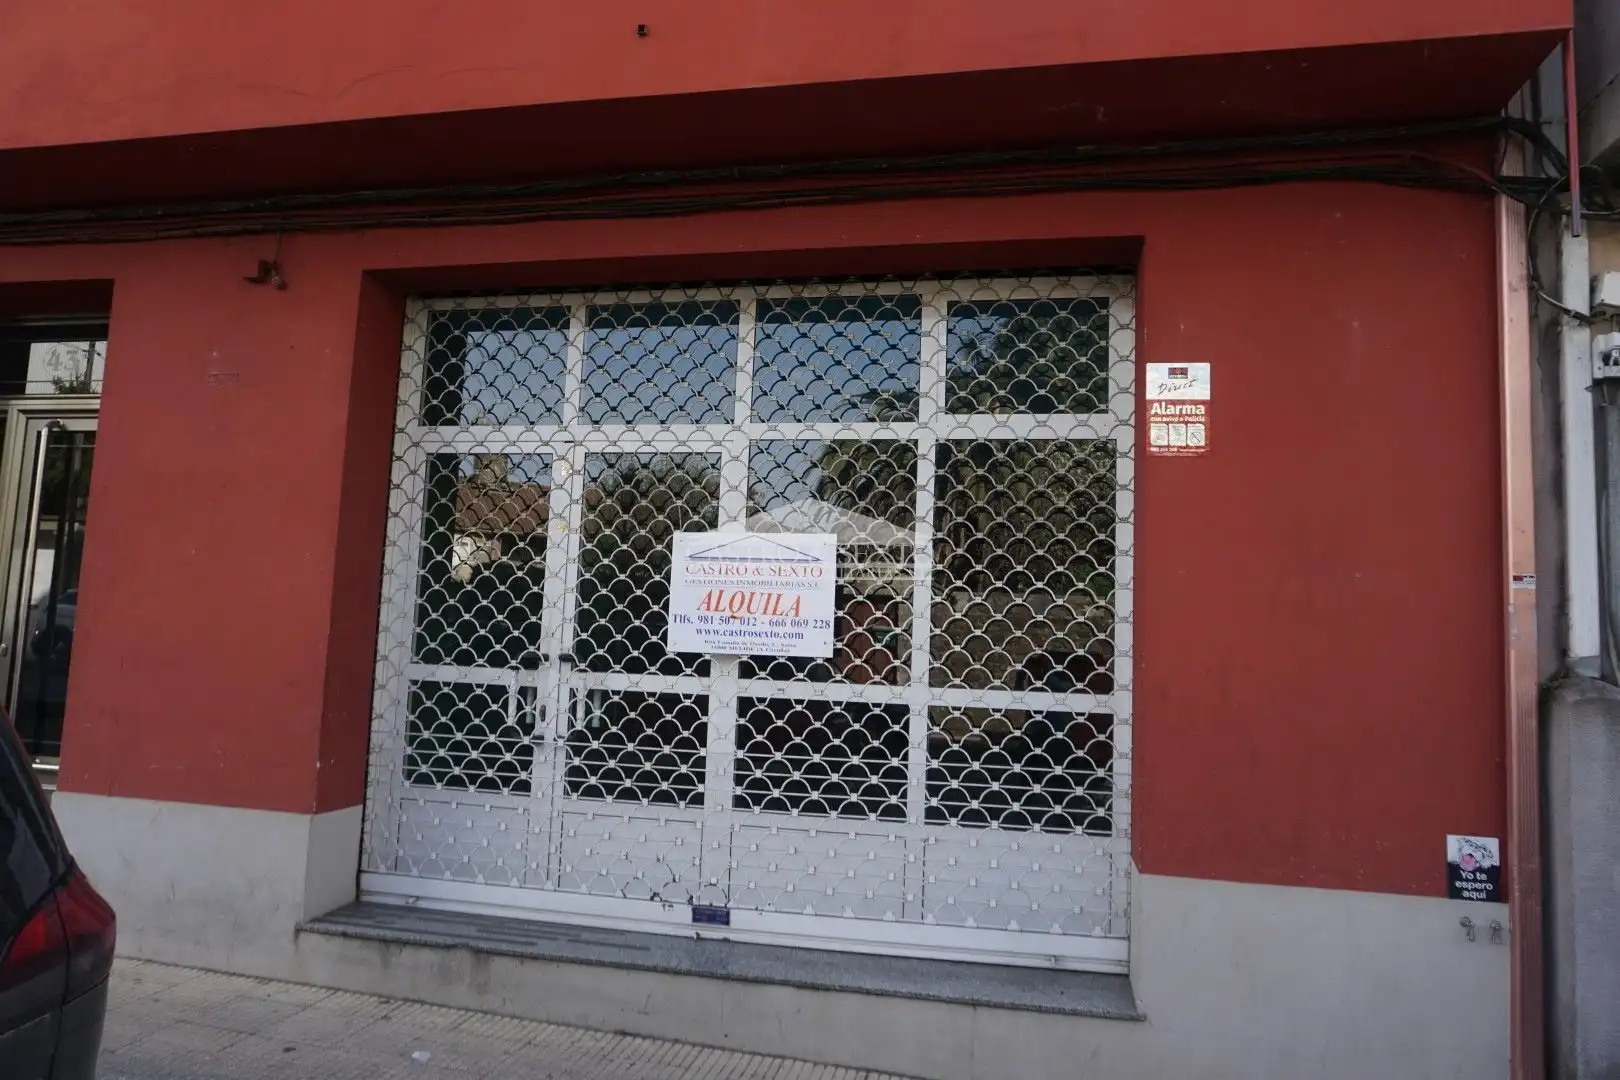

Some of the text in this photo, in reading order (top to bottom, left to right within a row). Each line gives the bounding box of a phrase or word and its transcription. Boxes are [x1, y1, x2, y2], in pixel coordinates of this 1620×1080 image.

[1150, 401, 1206, 415] Alarma
[685, 563, 748, 577] CASTRO
[752, 565, 765, 576] &
[768, 564, 823, 578] SEXTO
[697, 588, 802, 620] ALQUILA
[697, 615, 713, 626] 981
[718, 615, 736, 627] 507
[739, 616, 758, 627] 012
[768, 617, 788, 628] 666
[790, 618, 809, 629] 069
[812, 619, 831, 630] 228
[695, 627, 805, 641] www.castrosexto.com
[1460, 870, 1488, 881] Yo te
[1455, 880, 1494, 891] espero
[1462, 890, 1487, 900] aquí
